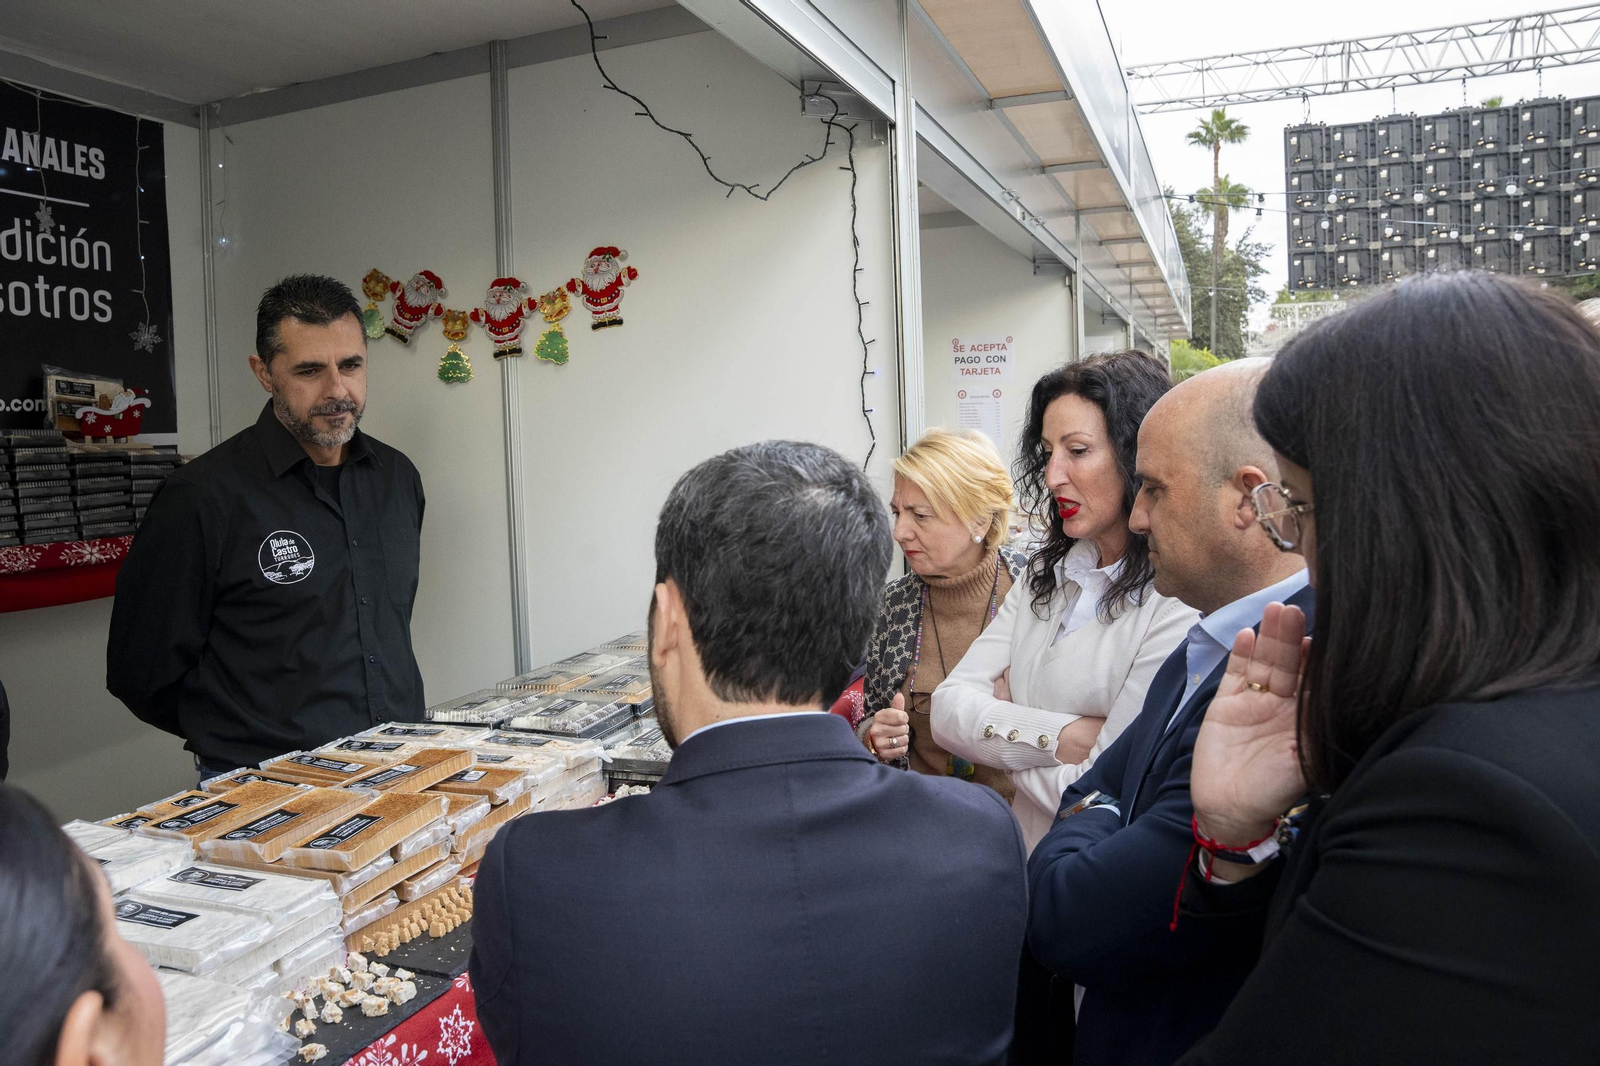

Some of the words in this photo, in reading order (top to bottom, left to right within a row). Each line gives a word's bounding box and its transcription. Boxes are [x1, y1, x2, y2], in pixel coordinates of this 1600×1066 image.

[1, 126, 106, 180] ANALES
[0, 217, 112, 272] dición
[0, 275, 113, 323] otros
[953, 344, 965, 353] SE
[970, 343, 1008, 352] ACEPTA
[954, 356, 981, 364] PAGO
[985, 355, 1006, 364] CON
[960, 367, 1001, 376] TARJETA
[271, 545, 298, 556] Castro
